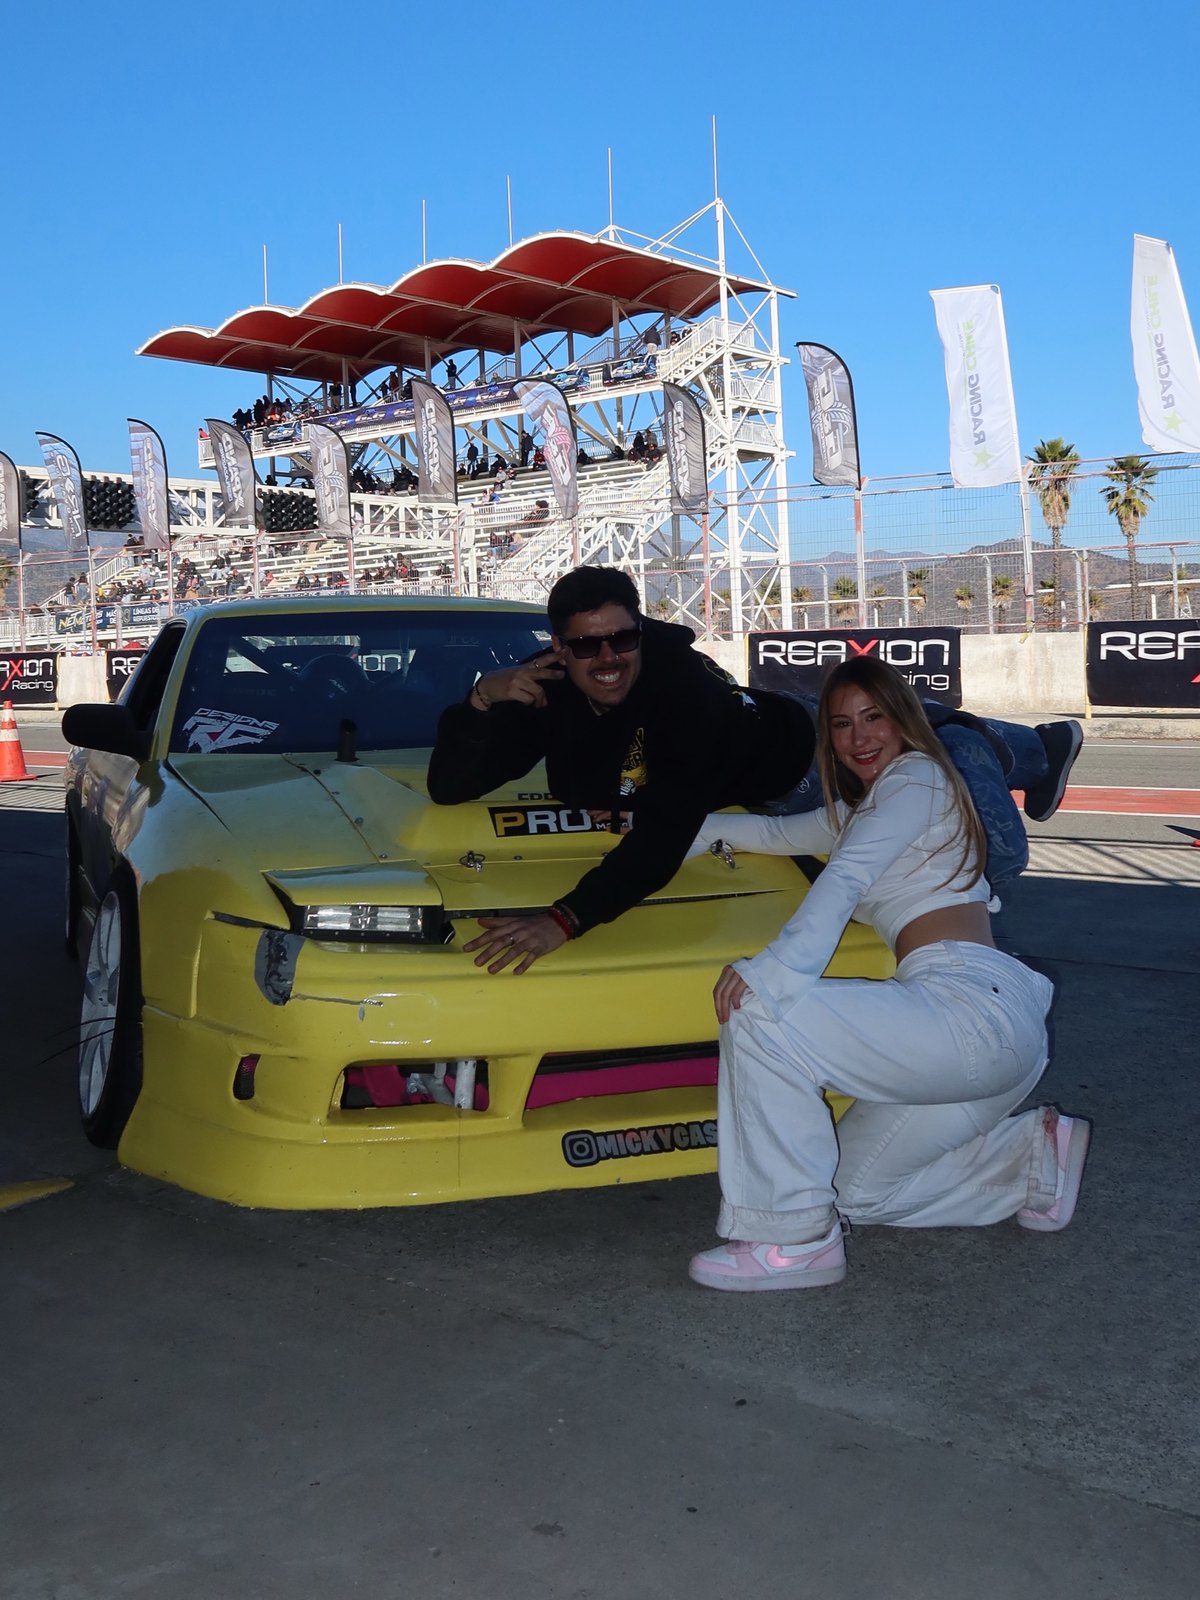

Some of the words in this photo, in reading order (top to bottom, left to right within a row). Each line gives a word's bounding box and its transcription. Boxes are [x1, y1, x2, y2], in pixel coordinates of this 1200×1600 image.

[12, 679, 54, 692] Racing
[901, 670, 950, 691] ing
[194, 707, 281, 731] DESIGNS
[494, 809, 592, 836] PRO
[596, 1124, 718, 1158] MICKYCAS
